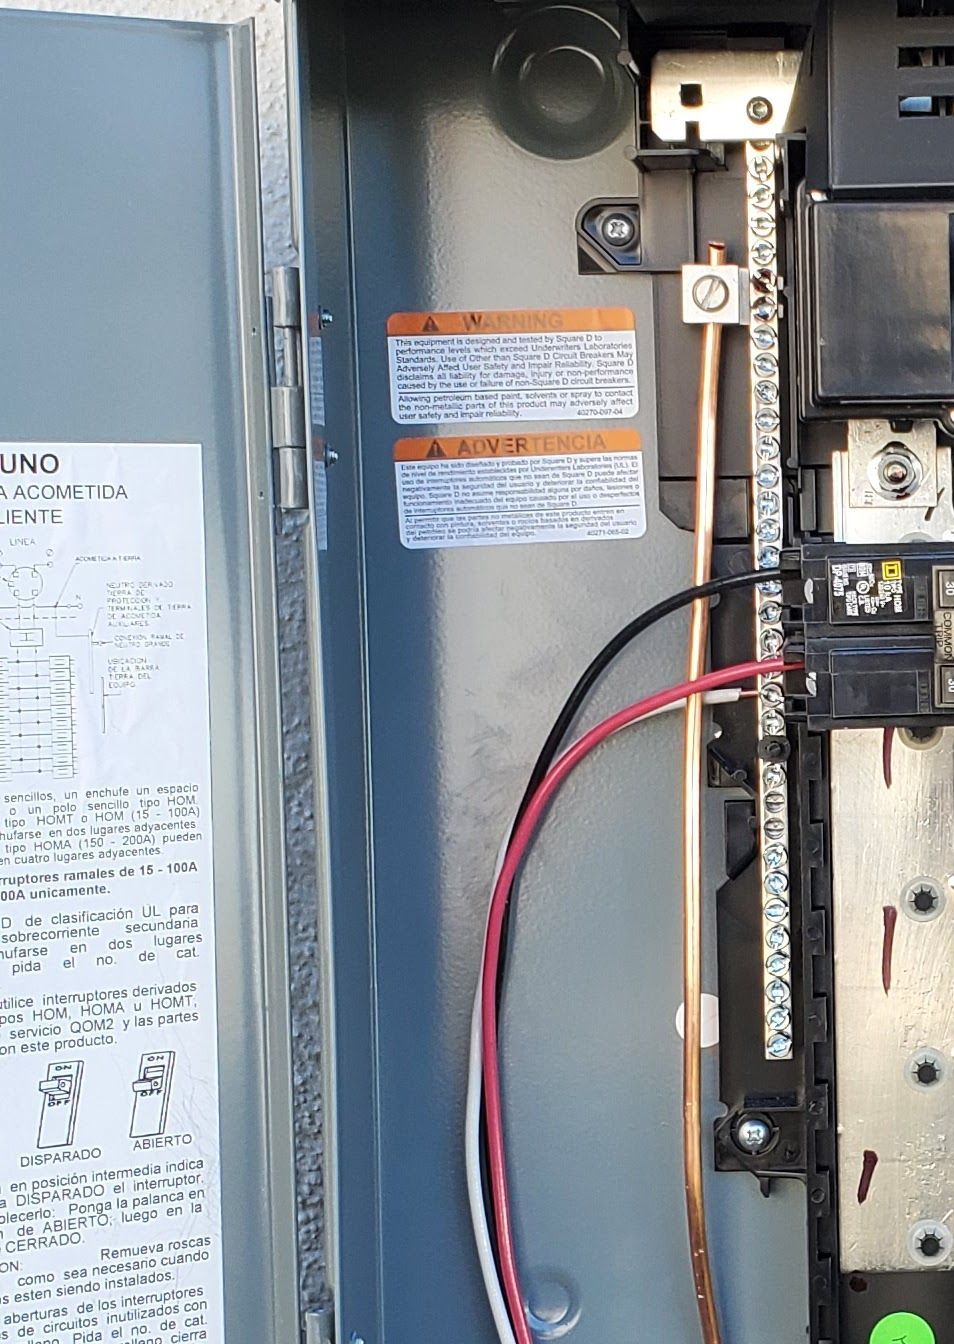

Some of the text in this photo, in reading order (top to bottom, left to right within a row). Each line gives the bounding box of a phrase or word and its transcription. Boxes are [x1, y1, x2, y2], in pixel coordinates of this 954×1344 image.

[462, 311, 563, 332] WARNING
[545, 336, 553, 344] by
[556, 335, 584, 343] Square
[458, 434, 607, 455] ADVERTENCIA
[0, 454, 59, 474] UNO
[14, 485, 128, 499] ACOMETIDA
[945, 581, 954, 595] 30
[4, 784, 199, 802] sencillos, un enchufe un espacio
[28, 806, 41, 814] un
[53, 804, 76, 815] polo
[88, 800, 129, 810] sencillo
[140, 798, 160, 809] tipo
[64, 868, 115, 882] ramales
[120, 867, 134, 877] de
[140, 865, 153, 875] 15
[168, 862, 197, 873] 100A
[30, 885, 110, 900] unicamente.
[2, 905, 199, 929] D de clasificación UL para
[2, 918, 198, 943] sobrecorriente secundaria
[43, 982, 196, 1006] interruptores derivados
[33, 995, 196, 1021] HOM, HOMA u HOMT,
[10, 1012, 199, 1039] servicio QOM2 y las partes
[133, 1134, 192, 1150] ABIERTO
[20, 1148, 101, 1167] DISPARADO
